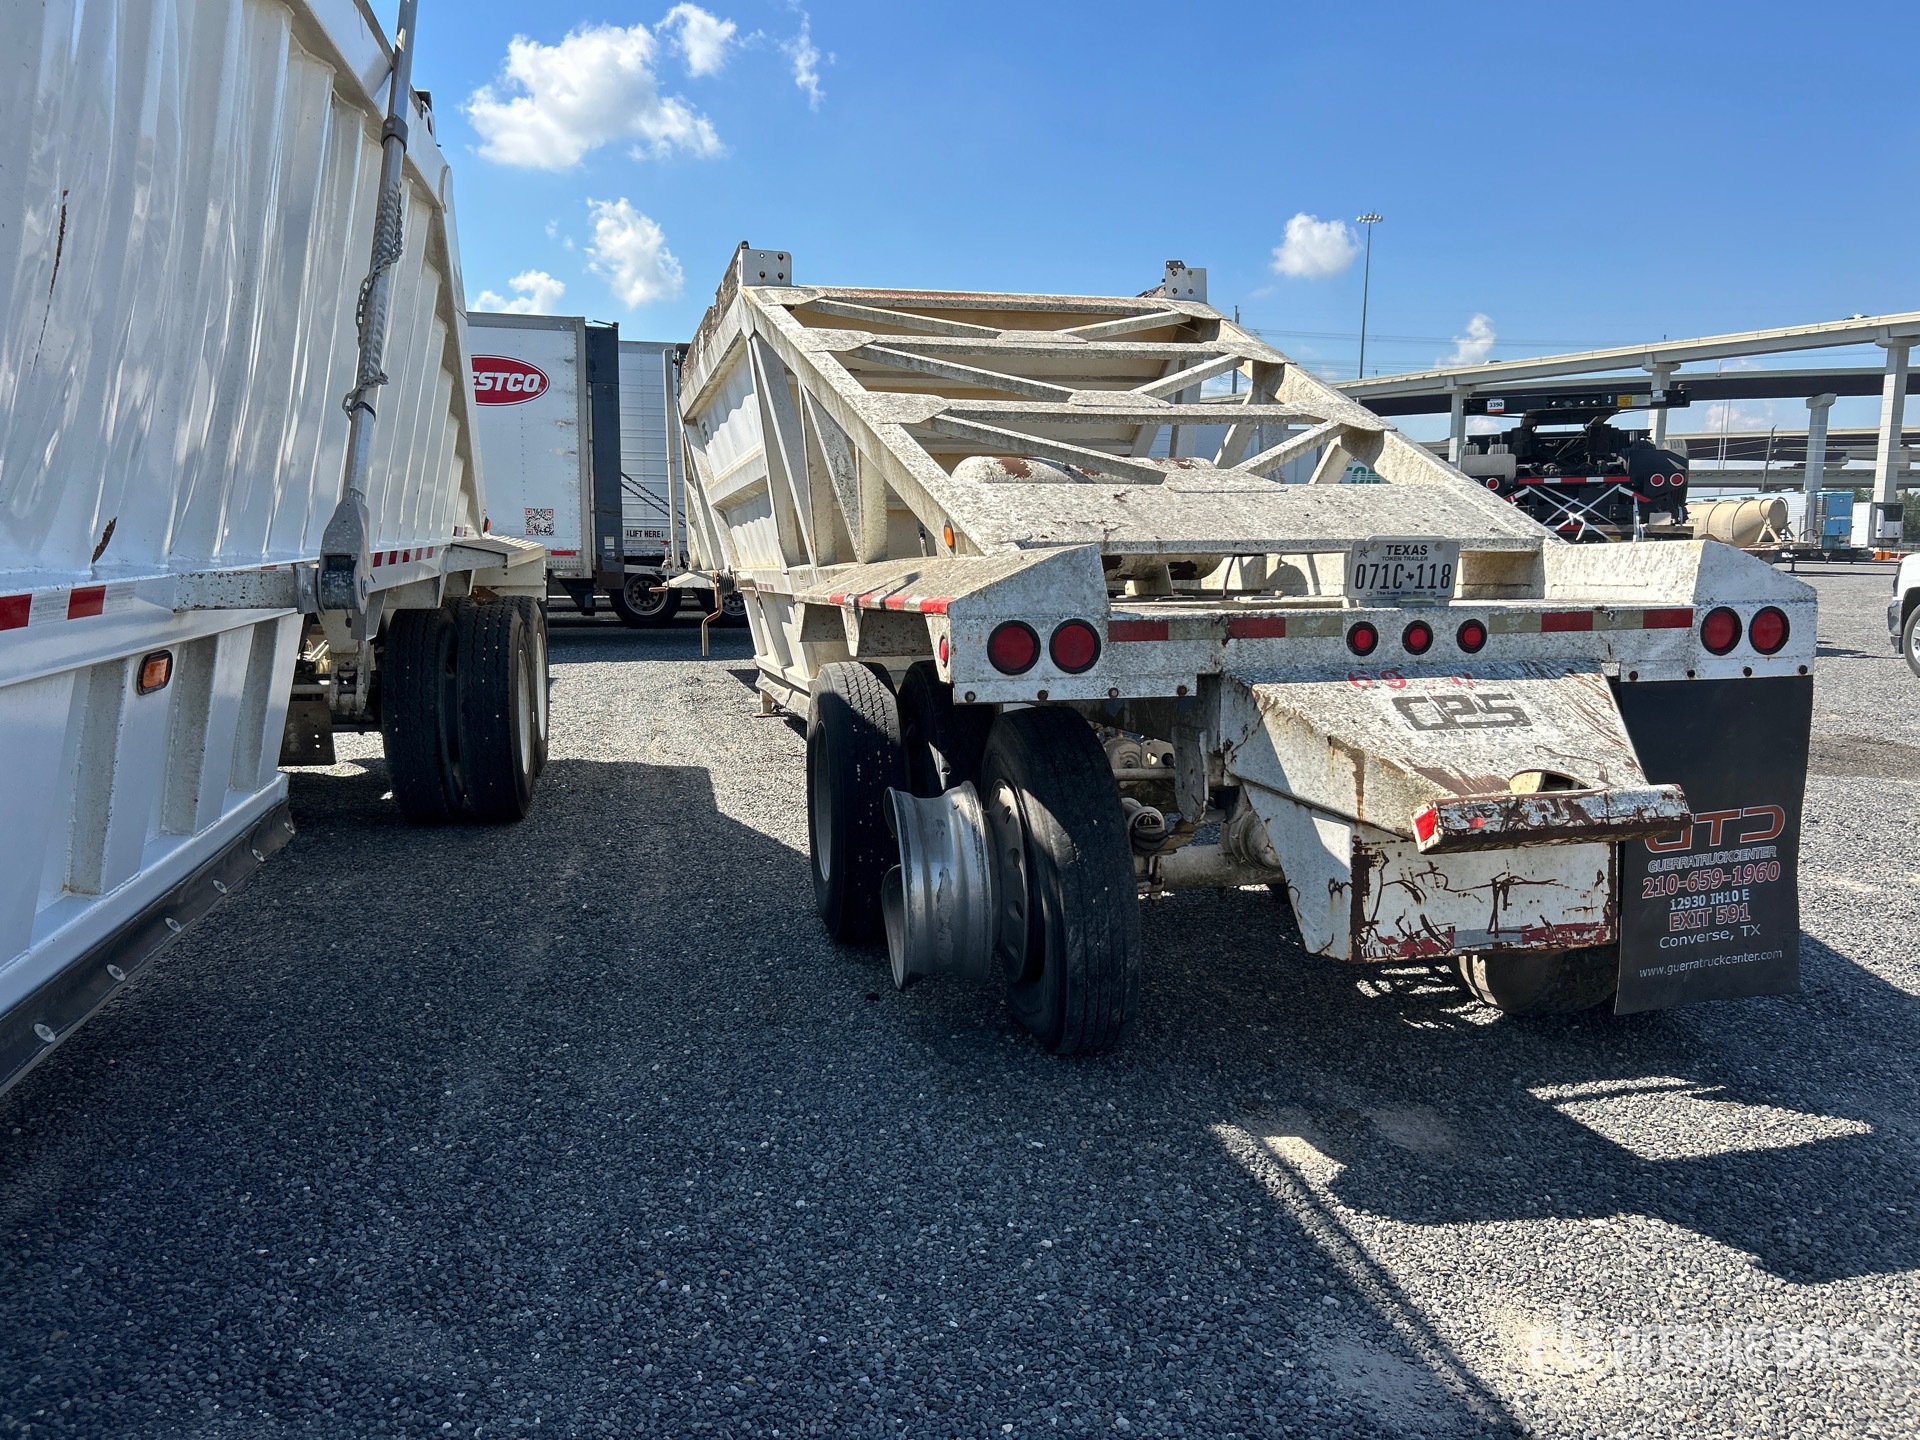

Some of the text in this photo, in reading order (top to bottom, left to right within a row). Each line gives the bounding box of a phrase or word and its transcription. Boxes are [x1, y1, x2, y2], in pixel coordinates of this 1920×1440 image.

[630, 530, 661, 538] LIFT HERE
[1385, 544, 1428, 556] TEXAS
[1391, 693, 1532, 731] CPS
[1648, 845, 1777, 873] GUERRATRUCKCENTER
[1641, 861, 1781, 899] 210-659-1960
[1670, 889, 1750, 911] 12930 IH10 E
[1669, 903, 1751, 932] EXIT 591
[1659, 924, 1761, 949] Converse, TX
[1639, 949, 1783, 977] www.guerratruckcenter.com
